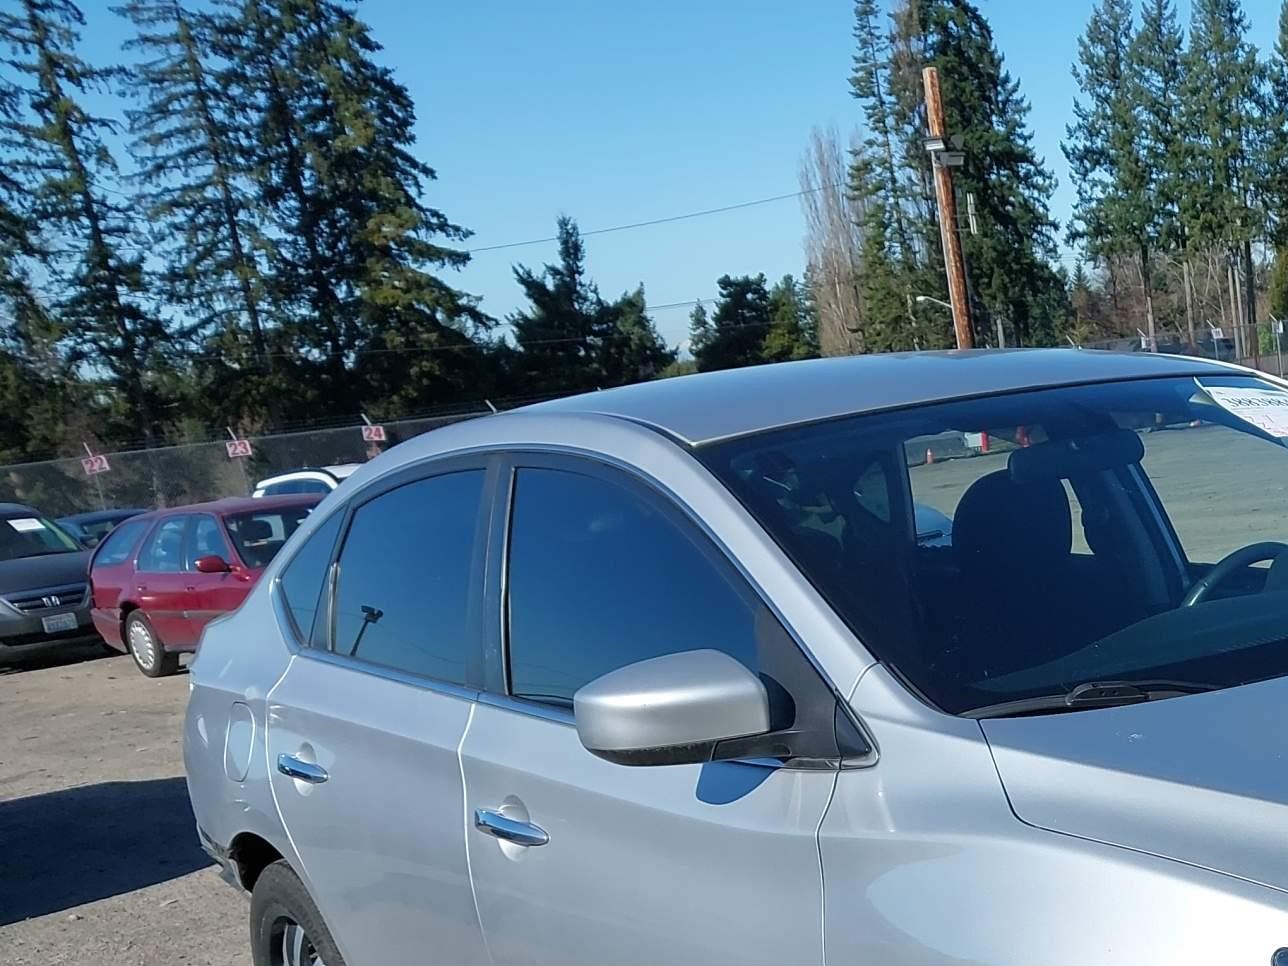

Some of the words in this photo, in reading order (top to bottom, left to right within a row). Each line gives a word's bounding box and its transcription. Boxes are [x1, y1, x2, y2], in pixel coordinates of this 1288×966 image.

[364, 427, 383, 440] 24
[229, 441, 250, 456] 23
[84, 457, 107, 473] 22
